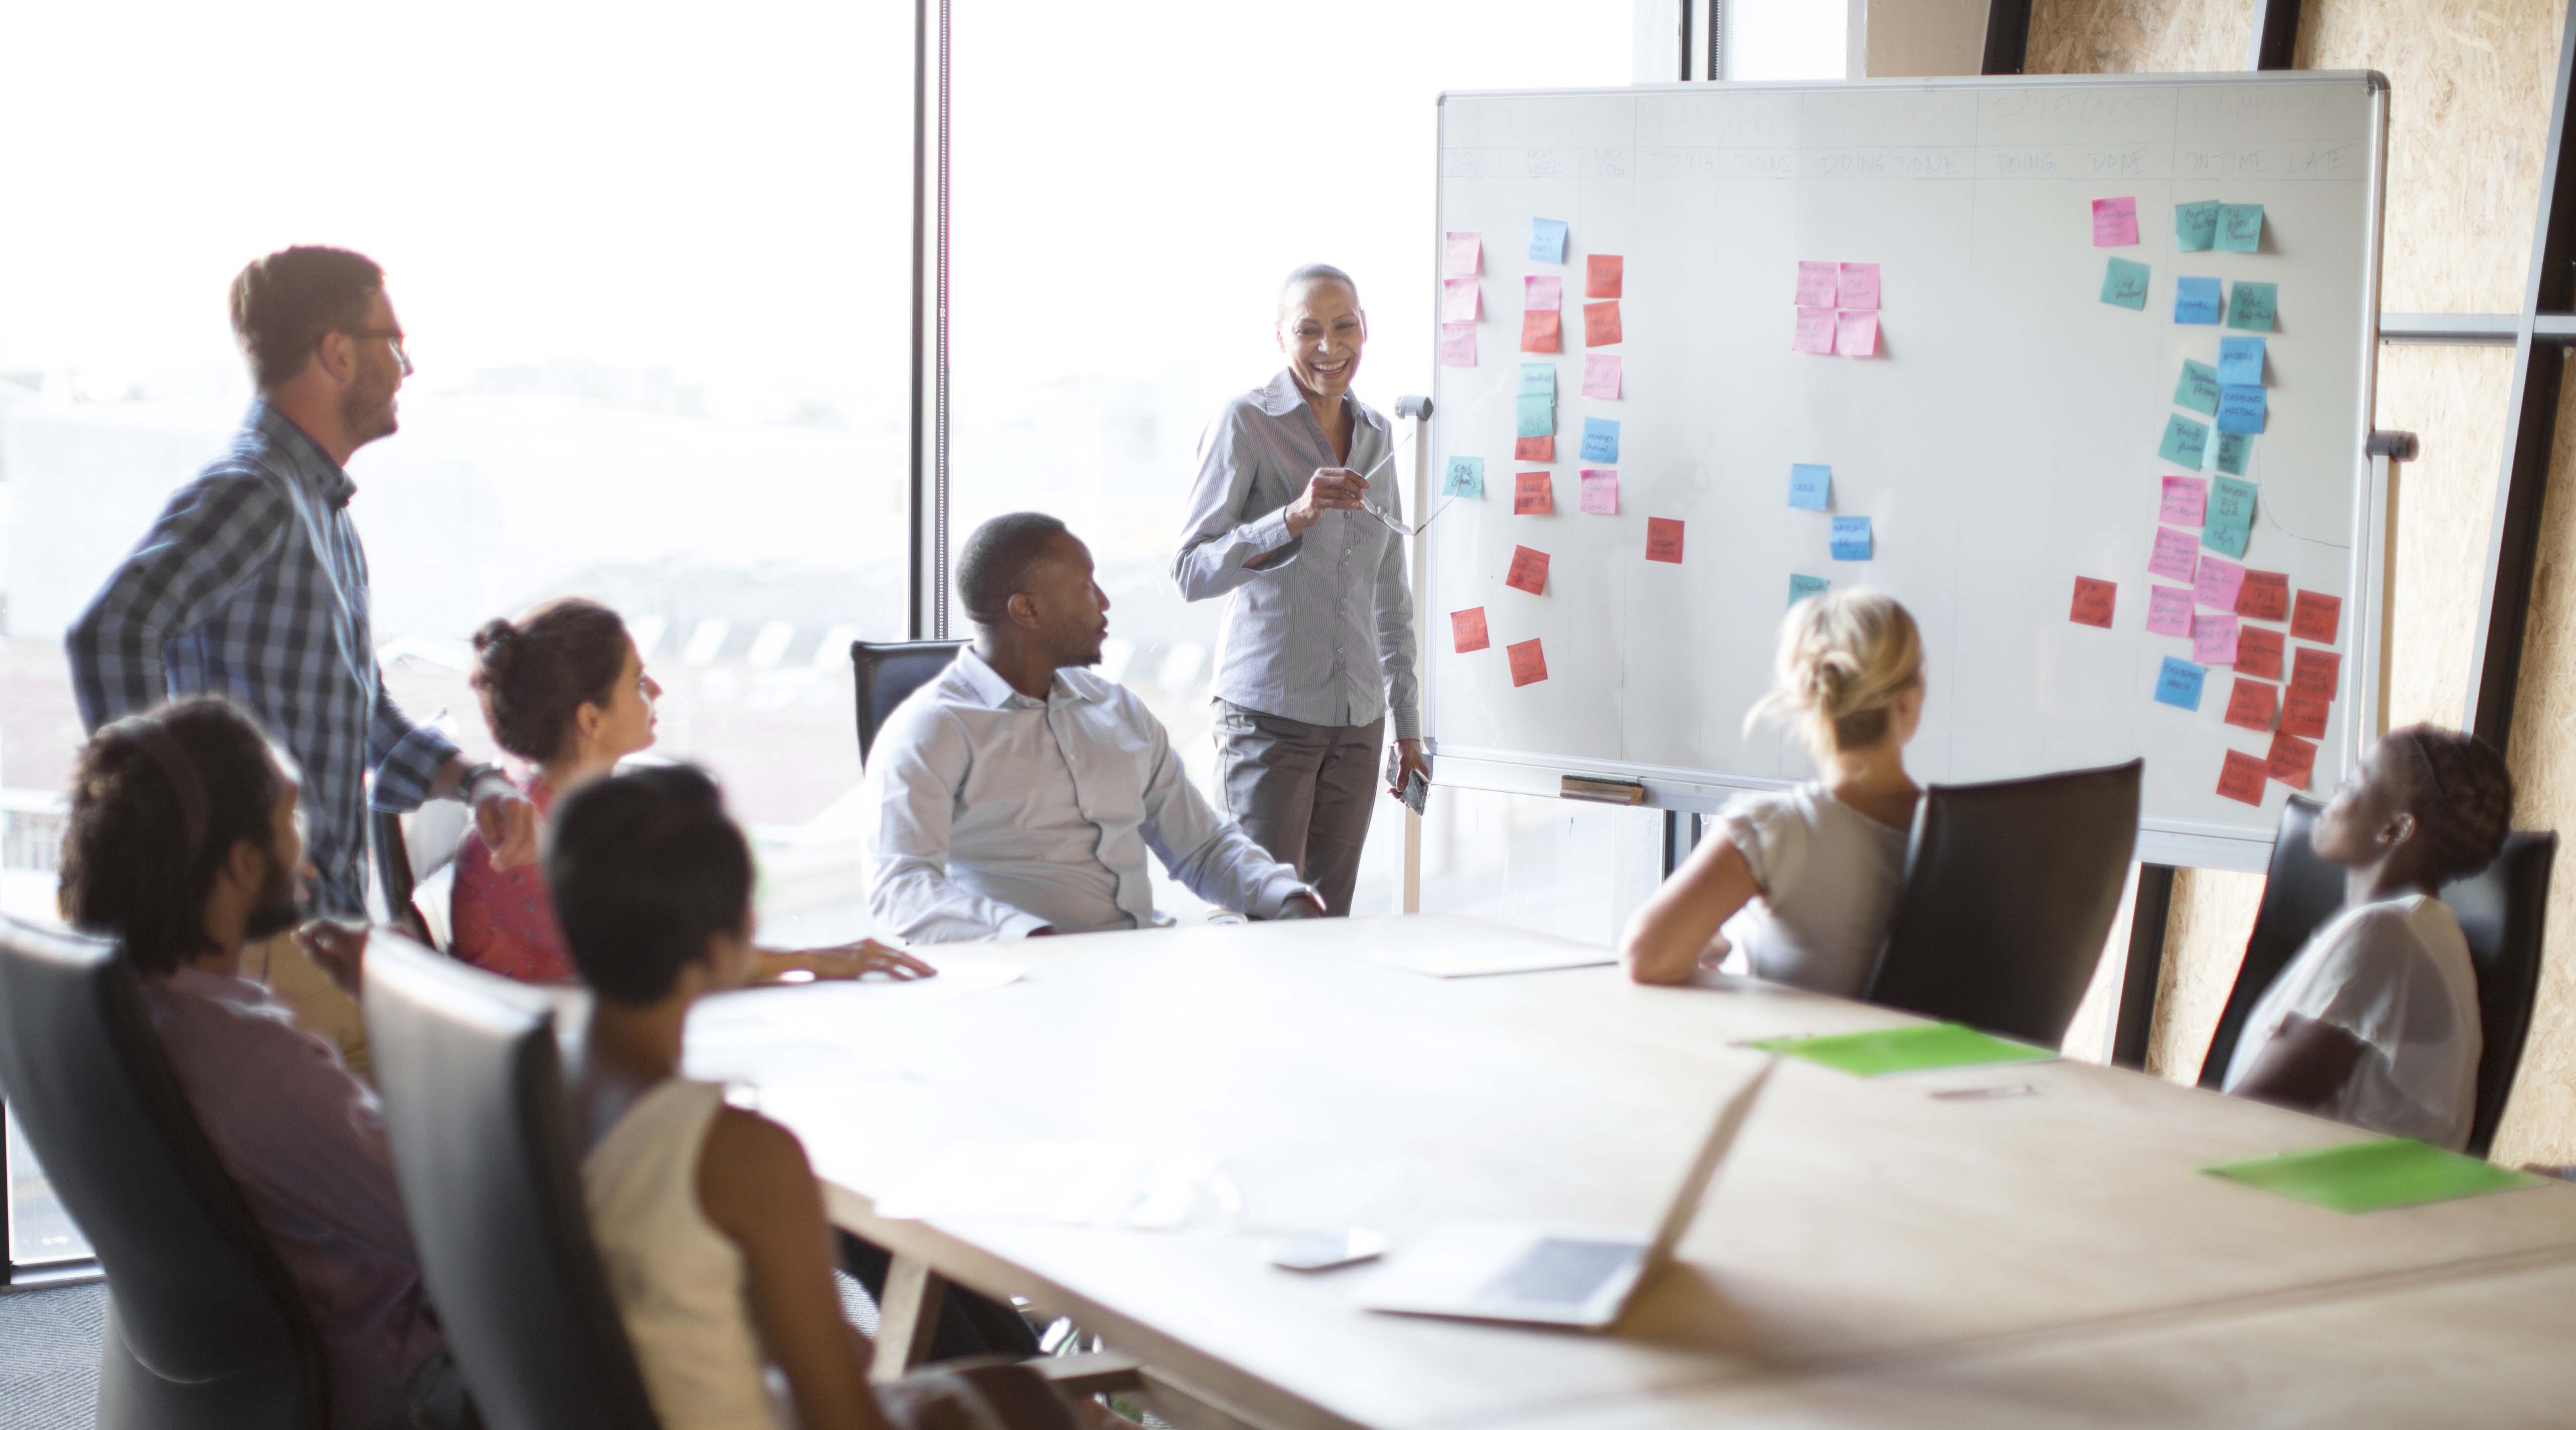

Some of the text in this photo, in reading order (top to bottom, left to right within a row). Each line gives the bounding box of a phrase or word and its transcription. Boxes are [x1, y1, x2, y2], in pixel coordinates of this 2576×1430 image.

[1652, 152, 1714, 172] DOING
[1733, 153, 1798, 172] DONE
[1820, 155, 1887, 174] DOING
[1894, 150, 1963, 175] DONE
[1996, 152, 2058, 176] DOING
[2087, 147, 2149, 175] DONE
[2289, 143, 2353, 173] LATE
